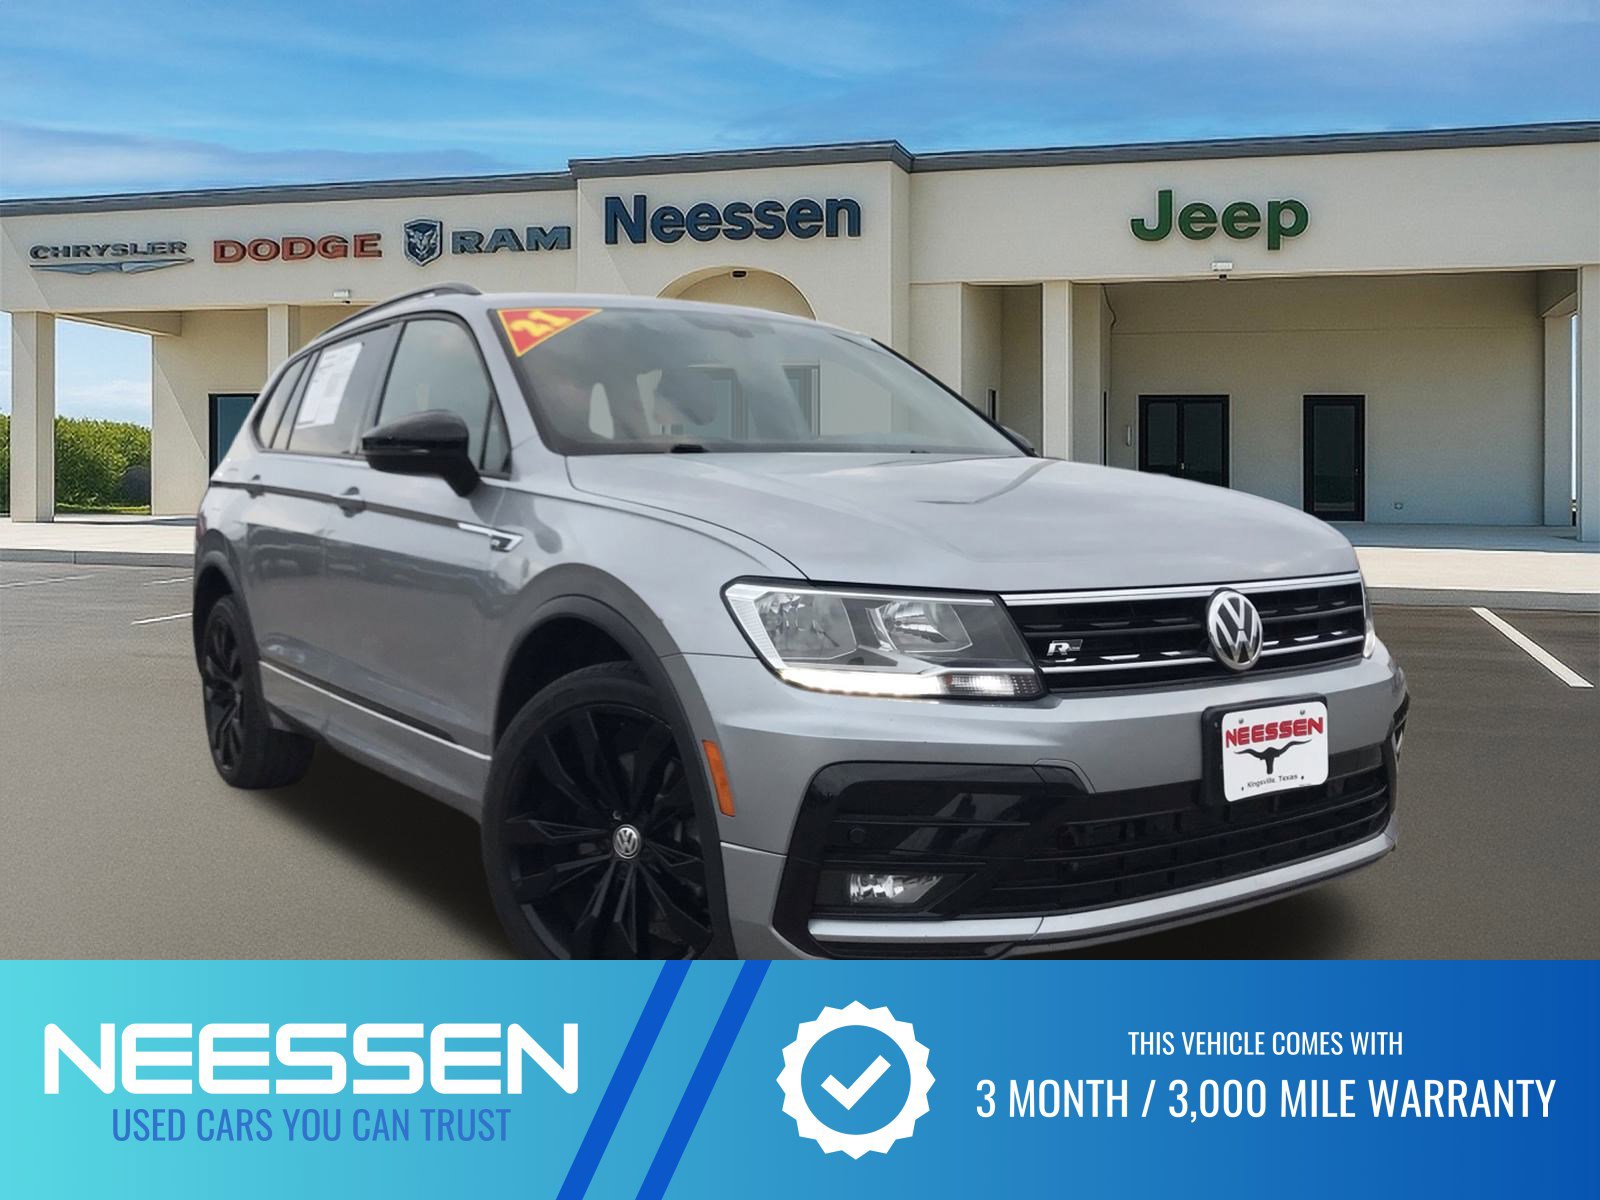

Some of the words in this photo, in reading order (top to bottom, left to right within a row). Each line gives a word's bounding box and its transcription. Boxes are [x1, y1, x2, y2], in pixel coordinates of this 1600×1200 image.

[604, 194, 862, 245] Neessen
[1130, 189, 1309, 251] Jeep
[29, 241, 188, 261] CHRYSLER
[213, 233, 384, 264] DODGE
[451, 226, 572, 254] RAM
[511, 309, 571, 337] 21
[1225, 716, 1323, 749] NEESSEN
[1278, 774, 1298, 783] Texas
